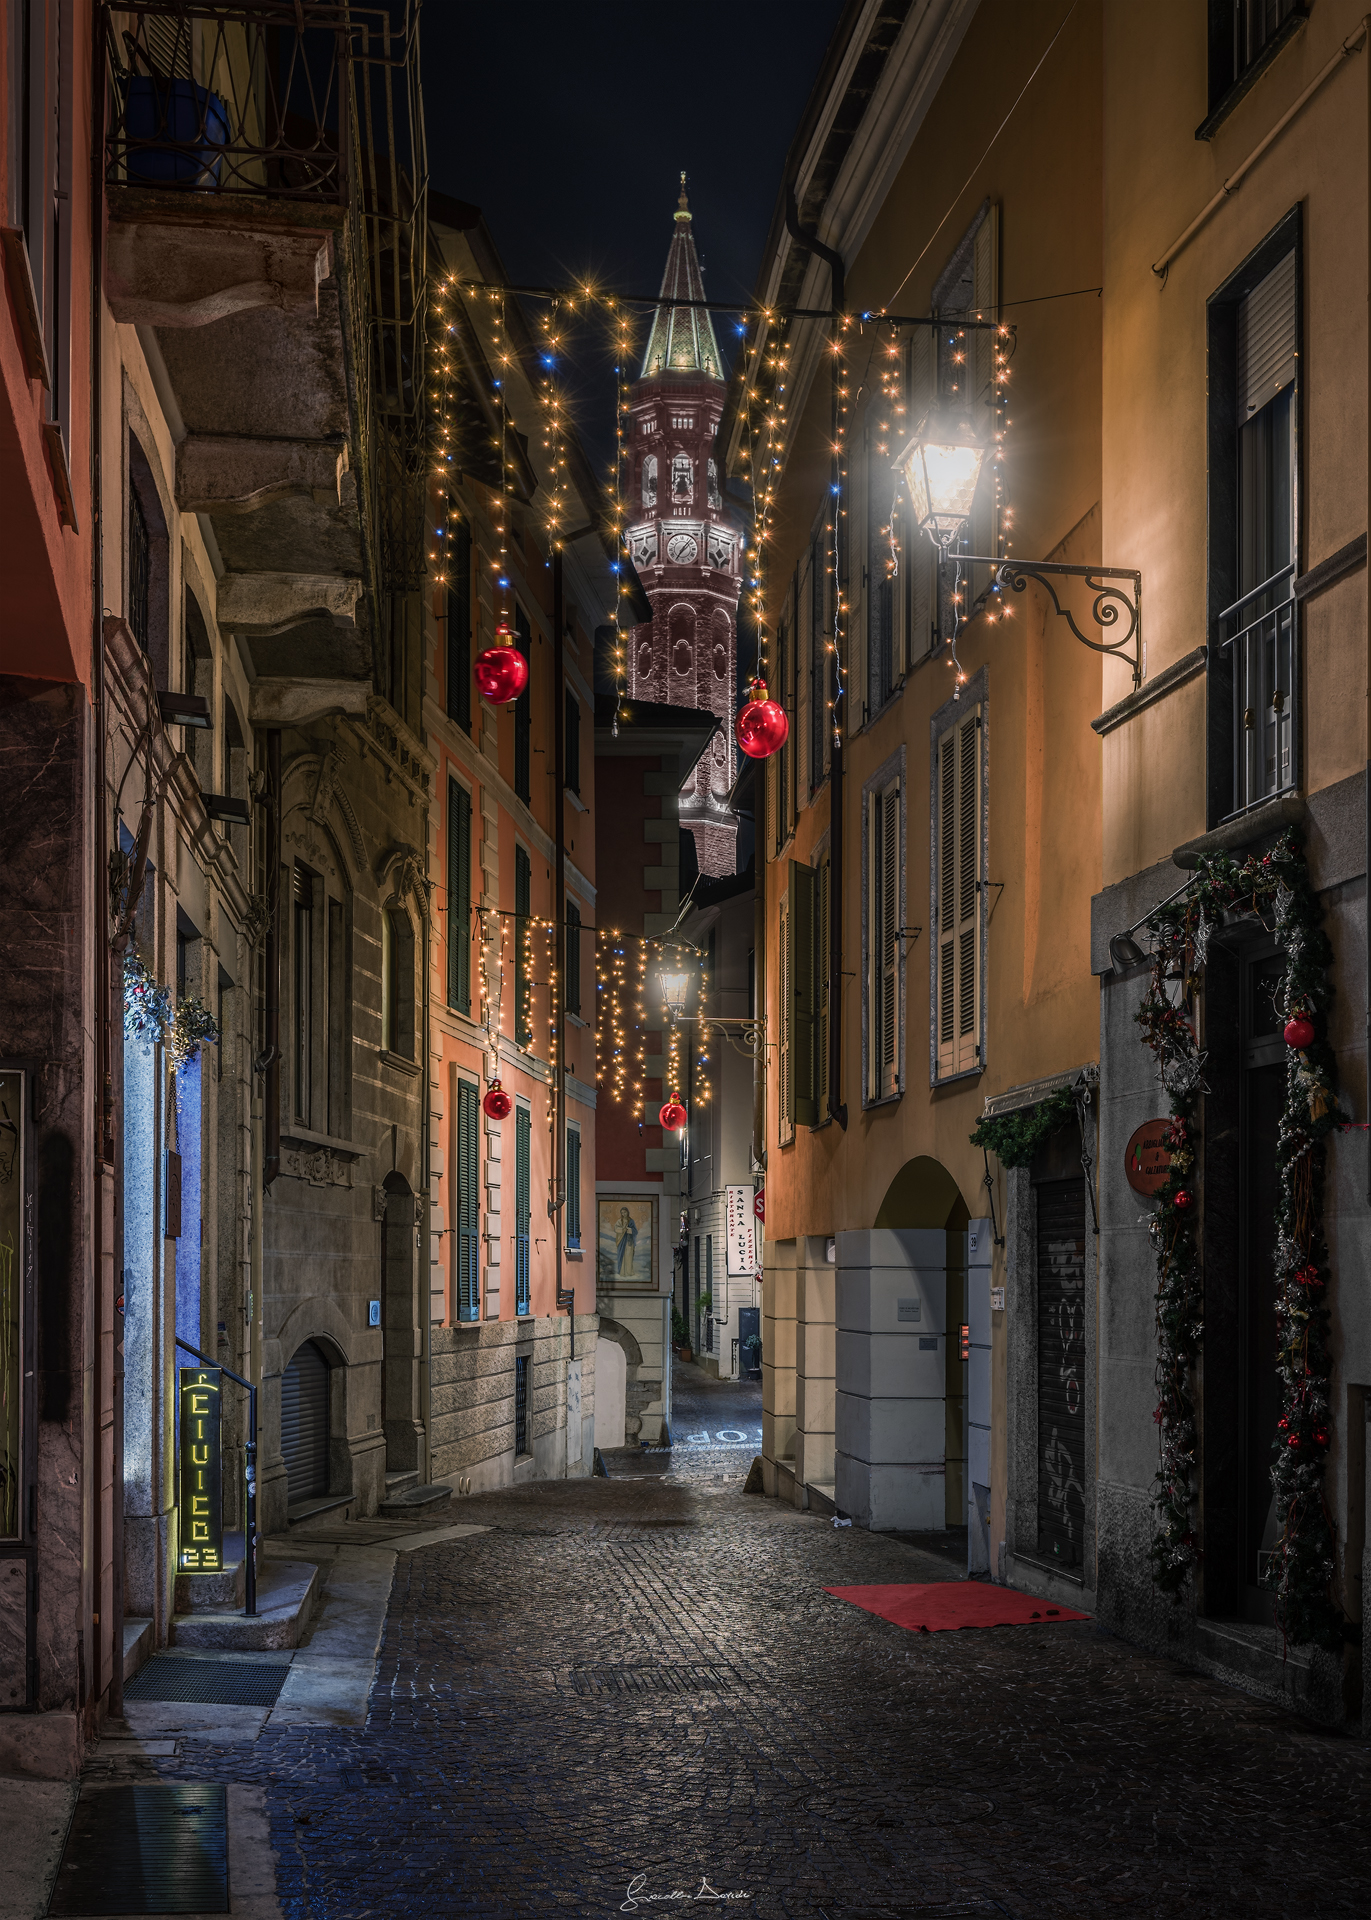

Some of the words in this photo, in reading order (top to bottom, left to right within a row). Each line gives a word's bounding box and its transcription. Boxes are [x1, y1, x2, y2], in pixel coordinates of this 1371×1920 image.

[736, 1189, 745, 1226] SANTA
[738, 1234, 747, 1271] LUCIA
[183, 1548, 219, 1567] 23
